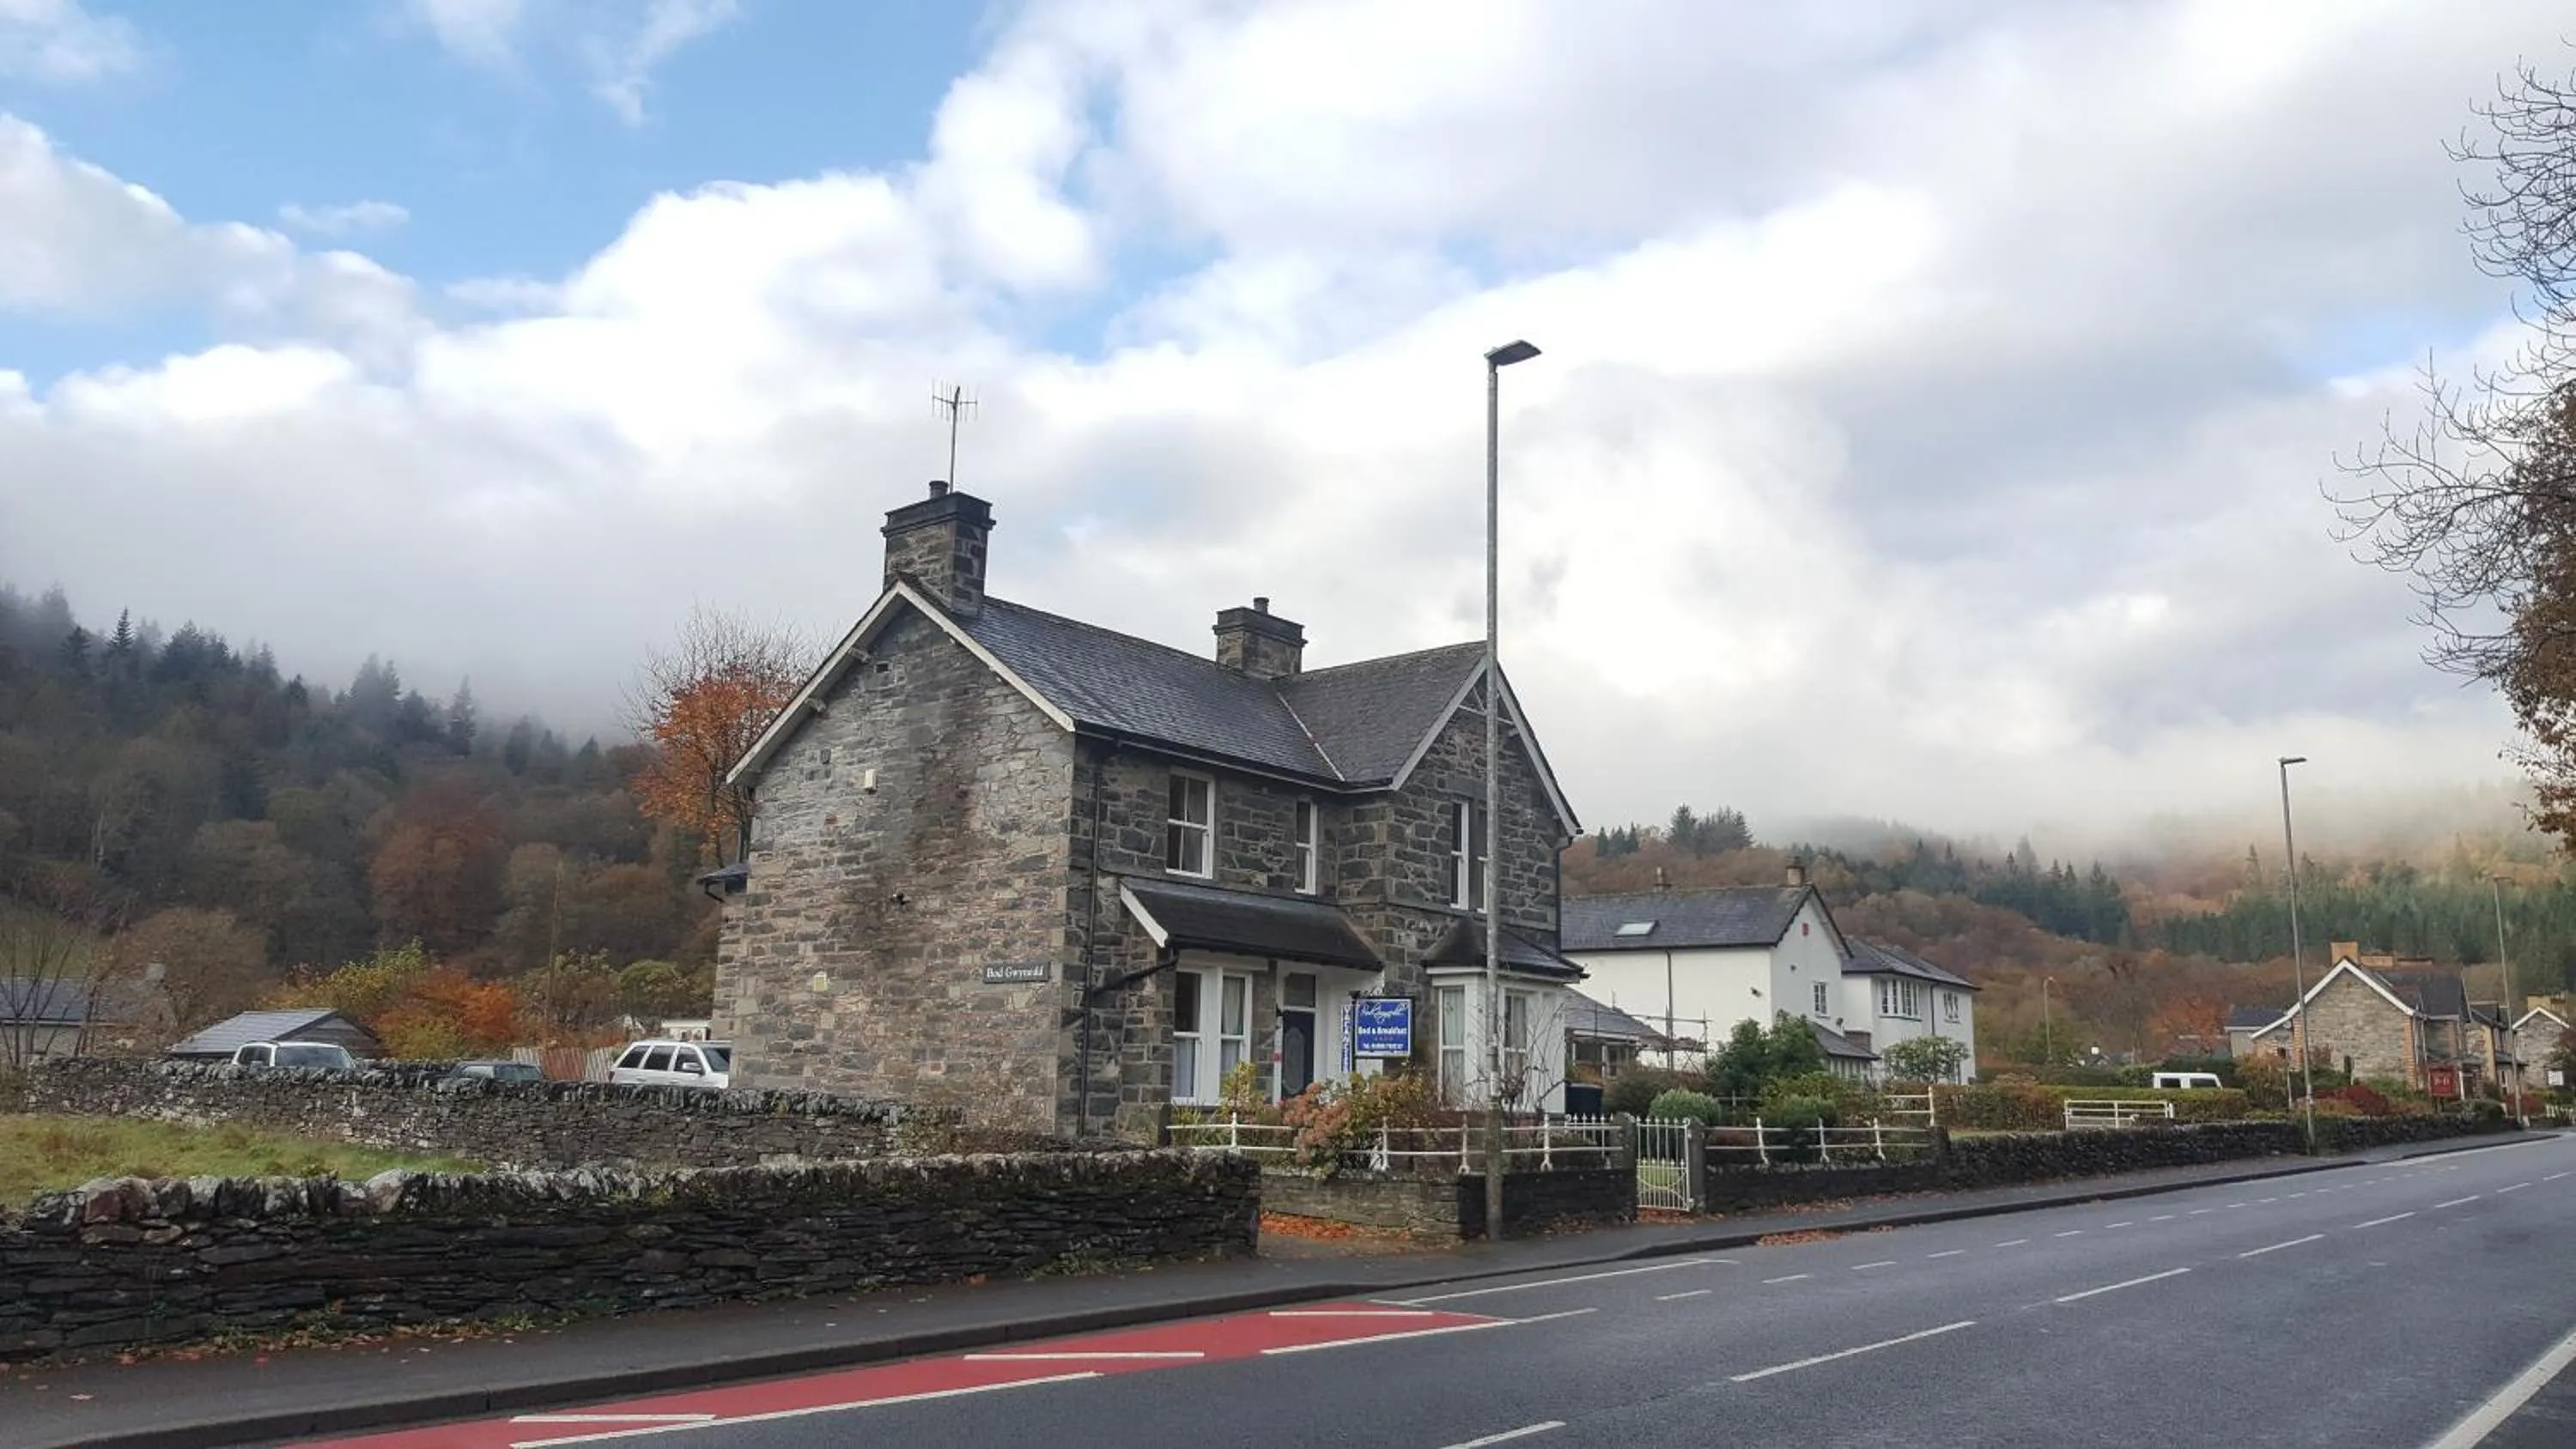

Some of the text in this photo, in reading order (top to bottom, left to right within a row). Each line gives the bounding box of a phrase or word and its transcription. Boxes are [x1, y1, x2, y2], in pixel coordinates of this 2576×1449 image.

[987, 966, 1004, 978] Bod
[1358, 1026, 1371, 1034] Bed
[1377, 1026, 1407, 1034] Breakfast
